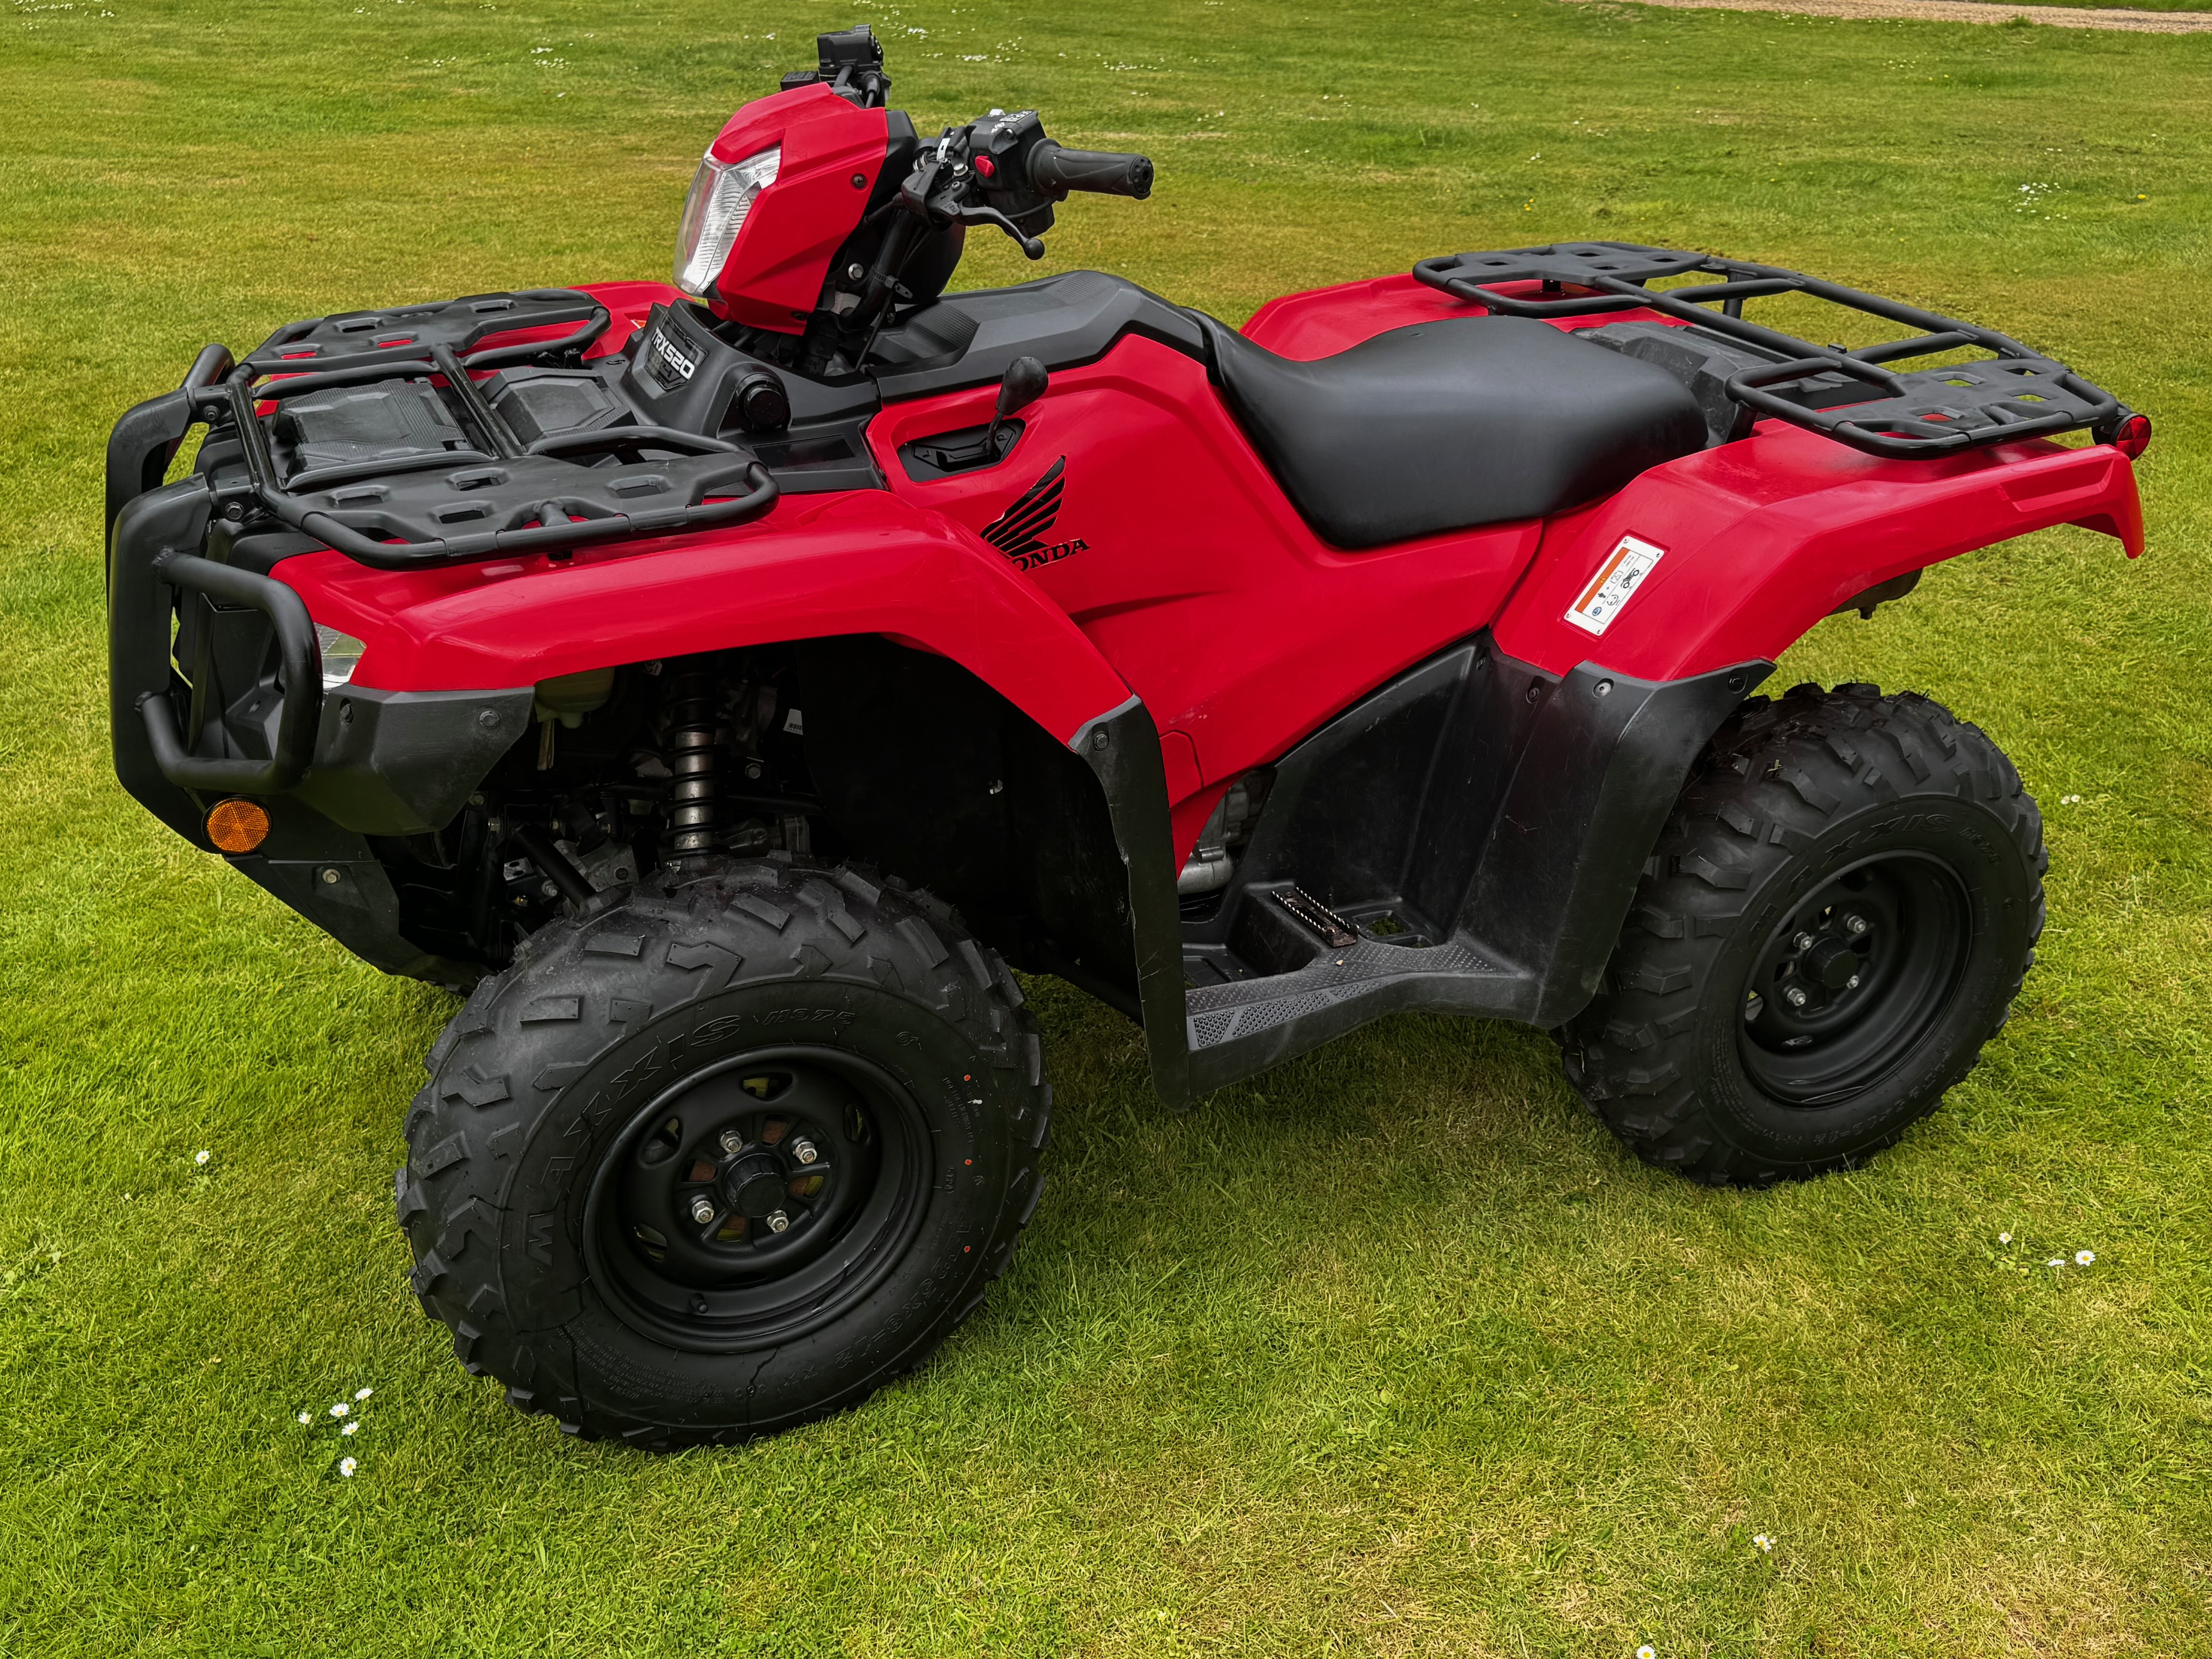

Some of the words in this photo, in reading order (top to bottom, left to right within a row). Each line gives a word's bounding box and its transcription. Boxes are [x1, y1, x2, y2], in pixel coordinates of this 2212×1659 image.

[651, 326, 695, 380] TRX520
[1011, 539, 1091, 572] ONDA
[528, 1015, 741, 1267] MAXXIS
[762, 1008, 857, 1026] M975
